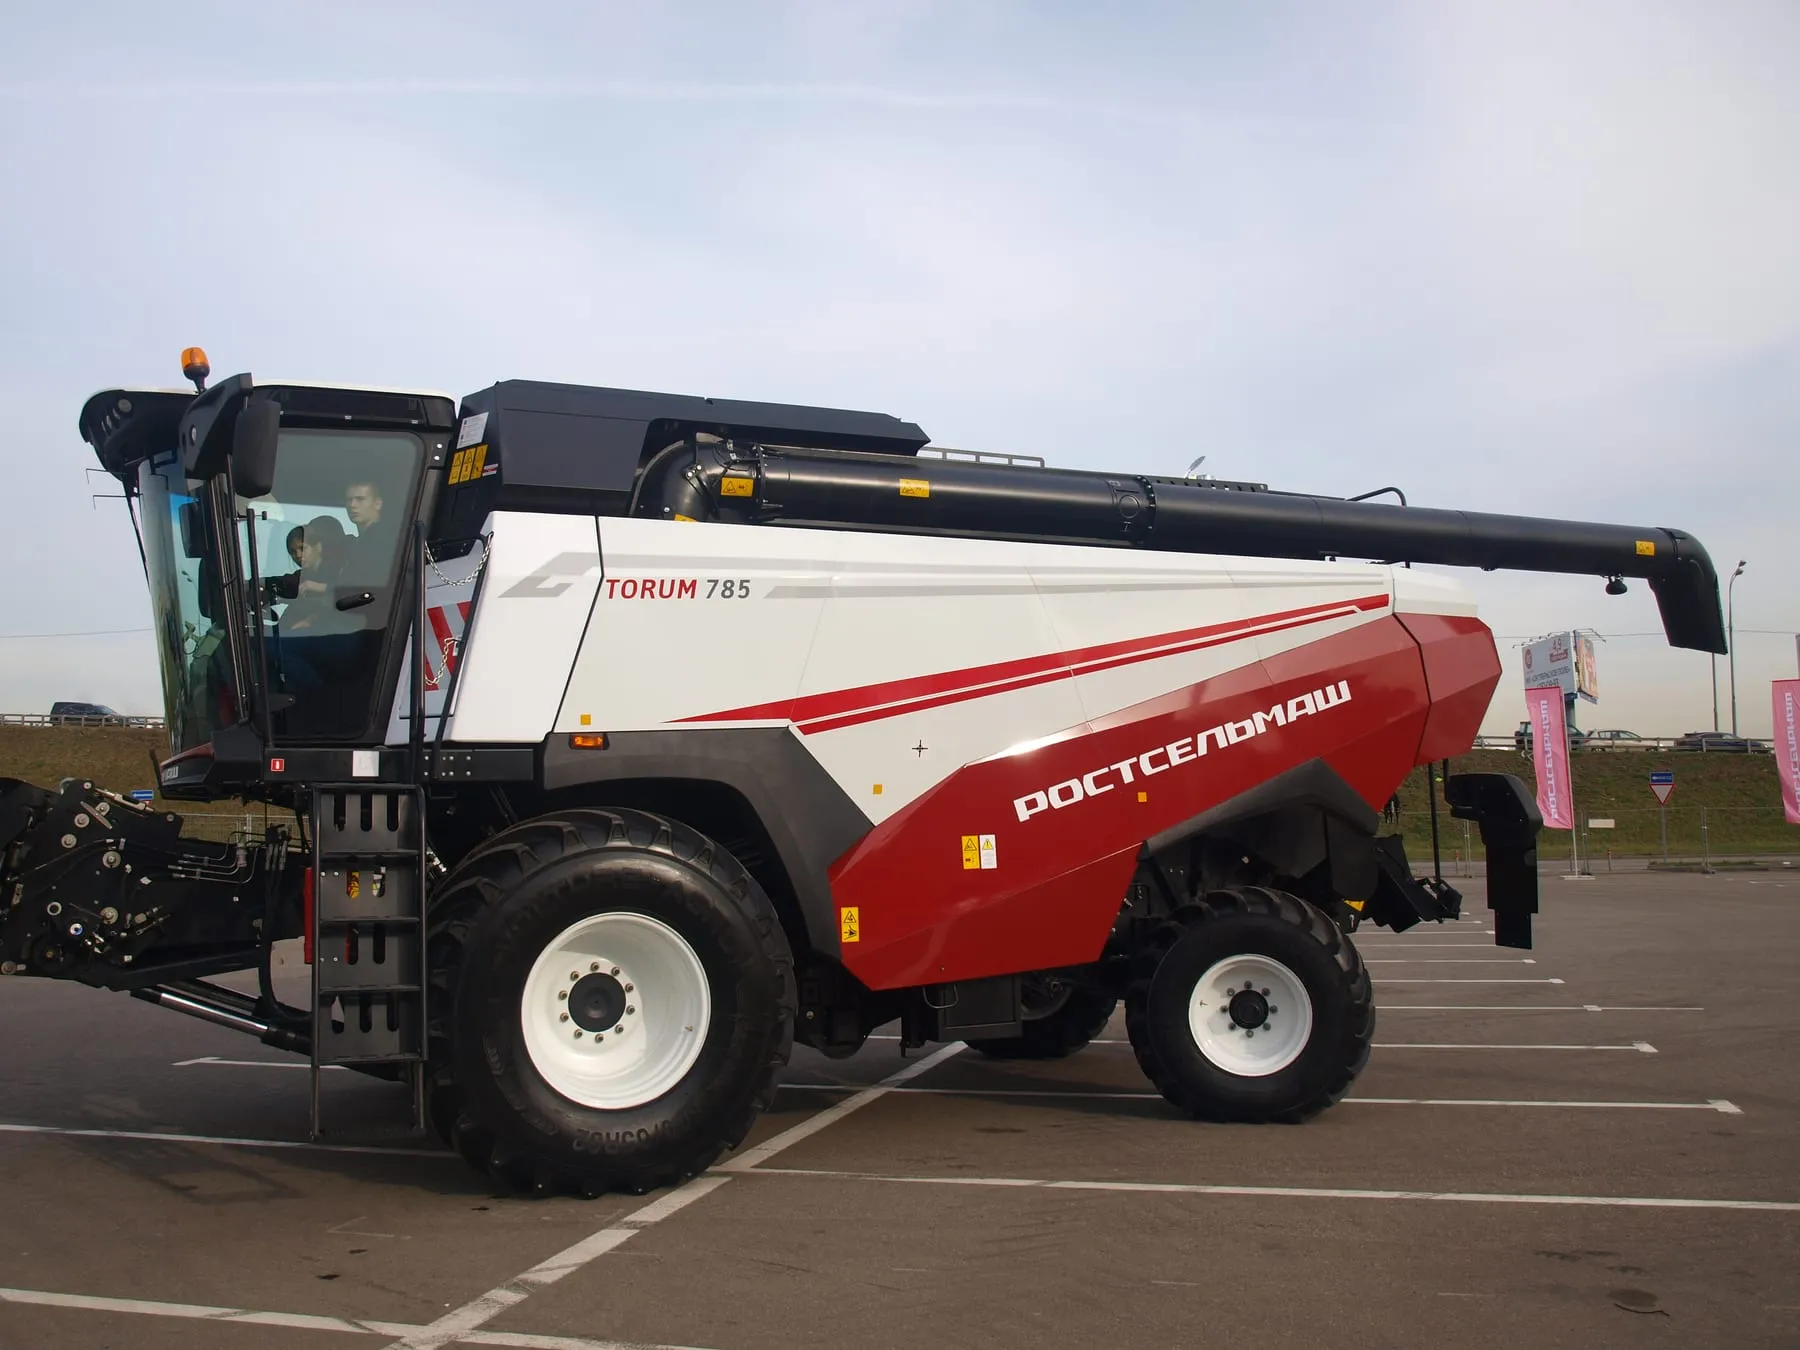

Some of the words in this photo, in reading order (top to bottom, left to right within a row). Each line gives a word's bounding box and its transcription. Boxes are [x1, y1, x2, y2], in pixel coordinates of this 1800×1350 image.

[605, 579, 698, 600] TORUM
[705, 579, 752, 599] 785
[1013, 680, 1352, 823] РОСТСЕЛЬМАШ
